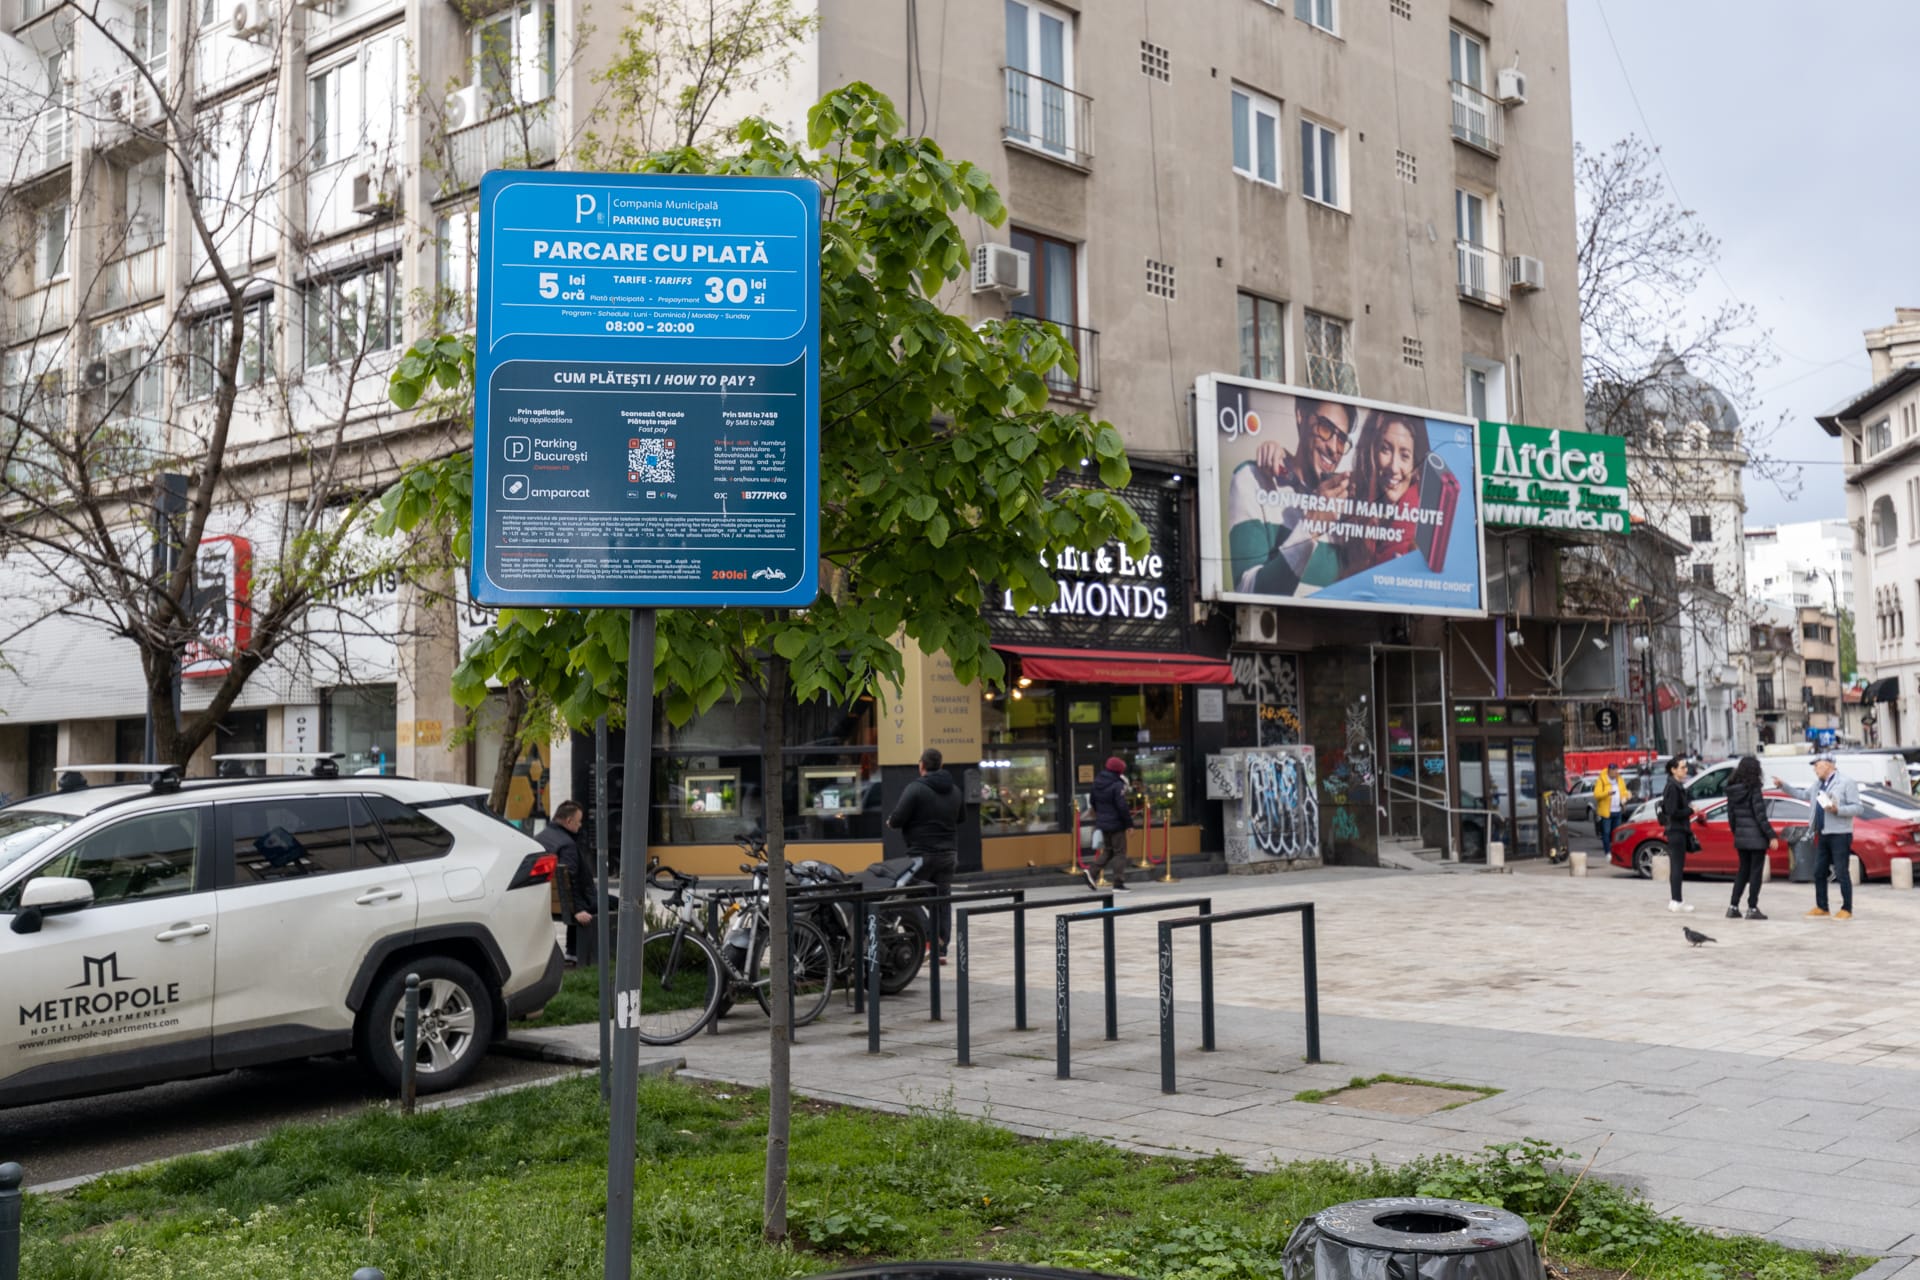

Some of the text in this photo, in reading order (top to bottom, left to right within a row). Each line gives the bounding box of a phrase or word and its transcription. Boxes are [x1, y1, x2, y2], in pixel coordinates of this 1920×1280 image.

[613, 199, 719, 212] Compania Municipală
[612, 215, 721, 229] PARKING BUCUREȘTI
[533, 240, 769, 264] PARCARE CU PLATĂ
[539, 272, 586, 299] 5 lei
[613, 275, 647, 285] TARIFE
[654, 276, 693, 286] TARIFFS
[561, 289, 585, 301] oră
[704, 276, 767, 304] 30 lei
[657, 296, 700, 304] Prepayment
[754, 293, 765, 305] zi
[561, 309, 592, 318] Program
[691, 312, 719, 320] Monday
[605, 321, 645, 332] 08:00
[656, 322, 695, 333] 20:00
[554, 372, 586, 384] CUM
[589, 371, 651, 387] PLĂTEȘTI
[664, 374, 697, 385] HOW
[700, 375, 717, 386] TO
[719, 375, 746, 386] PAY
[517, 408, 532, 416] Prin
[722, 411, 737, 419] Prin
[1219, 393, 1262, 442] glo
[509, 416, 573, 425] Using applications
[657, 418, 677, 426] rapid
[534, 438, 577, 451] Parking
[534, 452, 588, 463] București
[1492, 426, 1608, 484] Ardes
[531, 488, 590, 500] amparcat
[1256, 489, 1444, 525] CONVERSAȚII MAI PLĂCUTE
[1484, 502, 1624, 532] www.ardes.ro
[1303, 520, 1326, 535] MAI
[1328, 522, 1363, 542] PUȚIN
[1095, 547, 1113, 574] &
[1118, 542, 1163, 578] Eve
[711, 569, 748, 579] 200lei
[1373, 575, 1395, 585] YOUR
[1396, 577, 1423, 588] SMOKE
[1424, 580, 1441, 590] FREE
[1602, 712, 1611, 726] 5
[19, 982, 180, 1026] METROPOLE
[31, 1008, 167, 1036] HOTEL APARTMENTS
[18, 1017, 180, 1050] www.metropole-apartments.com
